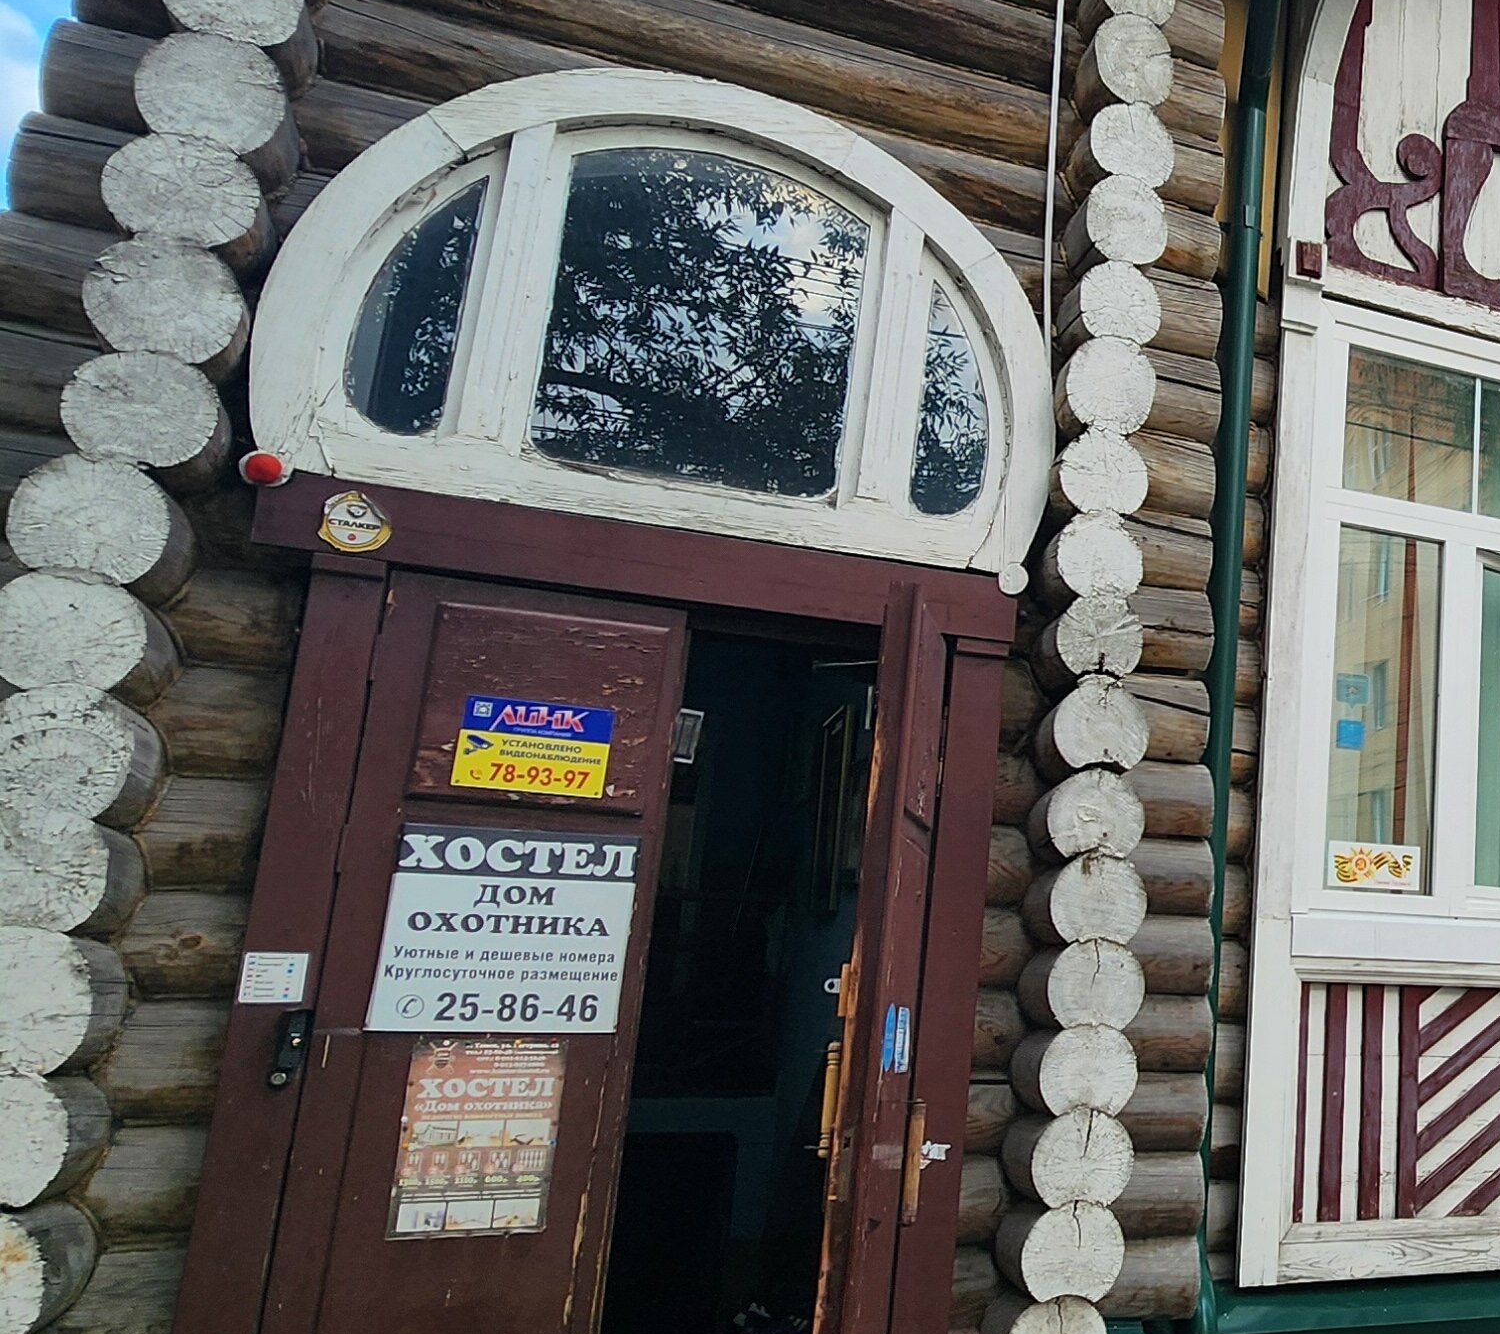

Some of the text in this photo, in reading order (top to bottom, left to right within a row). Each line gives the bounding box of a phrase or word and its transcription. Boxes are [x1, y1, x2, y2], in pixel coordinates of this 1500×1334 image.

[489, 704, 590, 733] ЛИНК
[499, 749, 602, 765] ВИДЕОНАБЛЮДЕНИЕ
[501, 739, 582, 754] УСТАНОВЛЕНО
[489, 762, 591, 789] 78-93-97
[398, 834, 638, 878] ХОСТЕЛ
[473, 884, 556, 908] ДОМ
[407, 911, 610, 937] ОХОТНИКА
[394, 945, 615, 965] Уютные и дешевые номера
[384, 964, 618, 983] Круглосуточное размещение
[433, 992, 599, 1022] 25-86-46
[416, 1077, 556, 1099] ХОСТЕЛ
